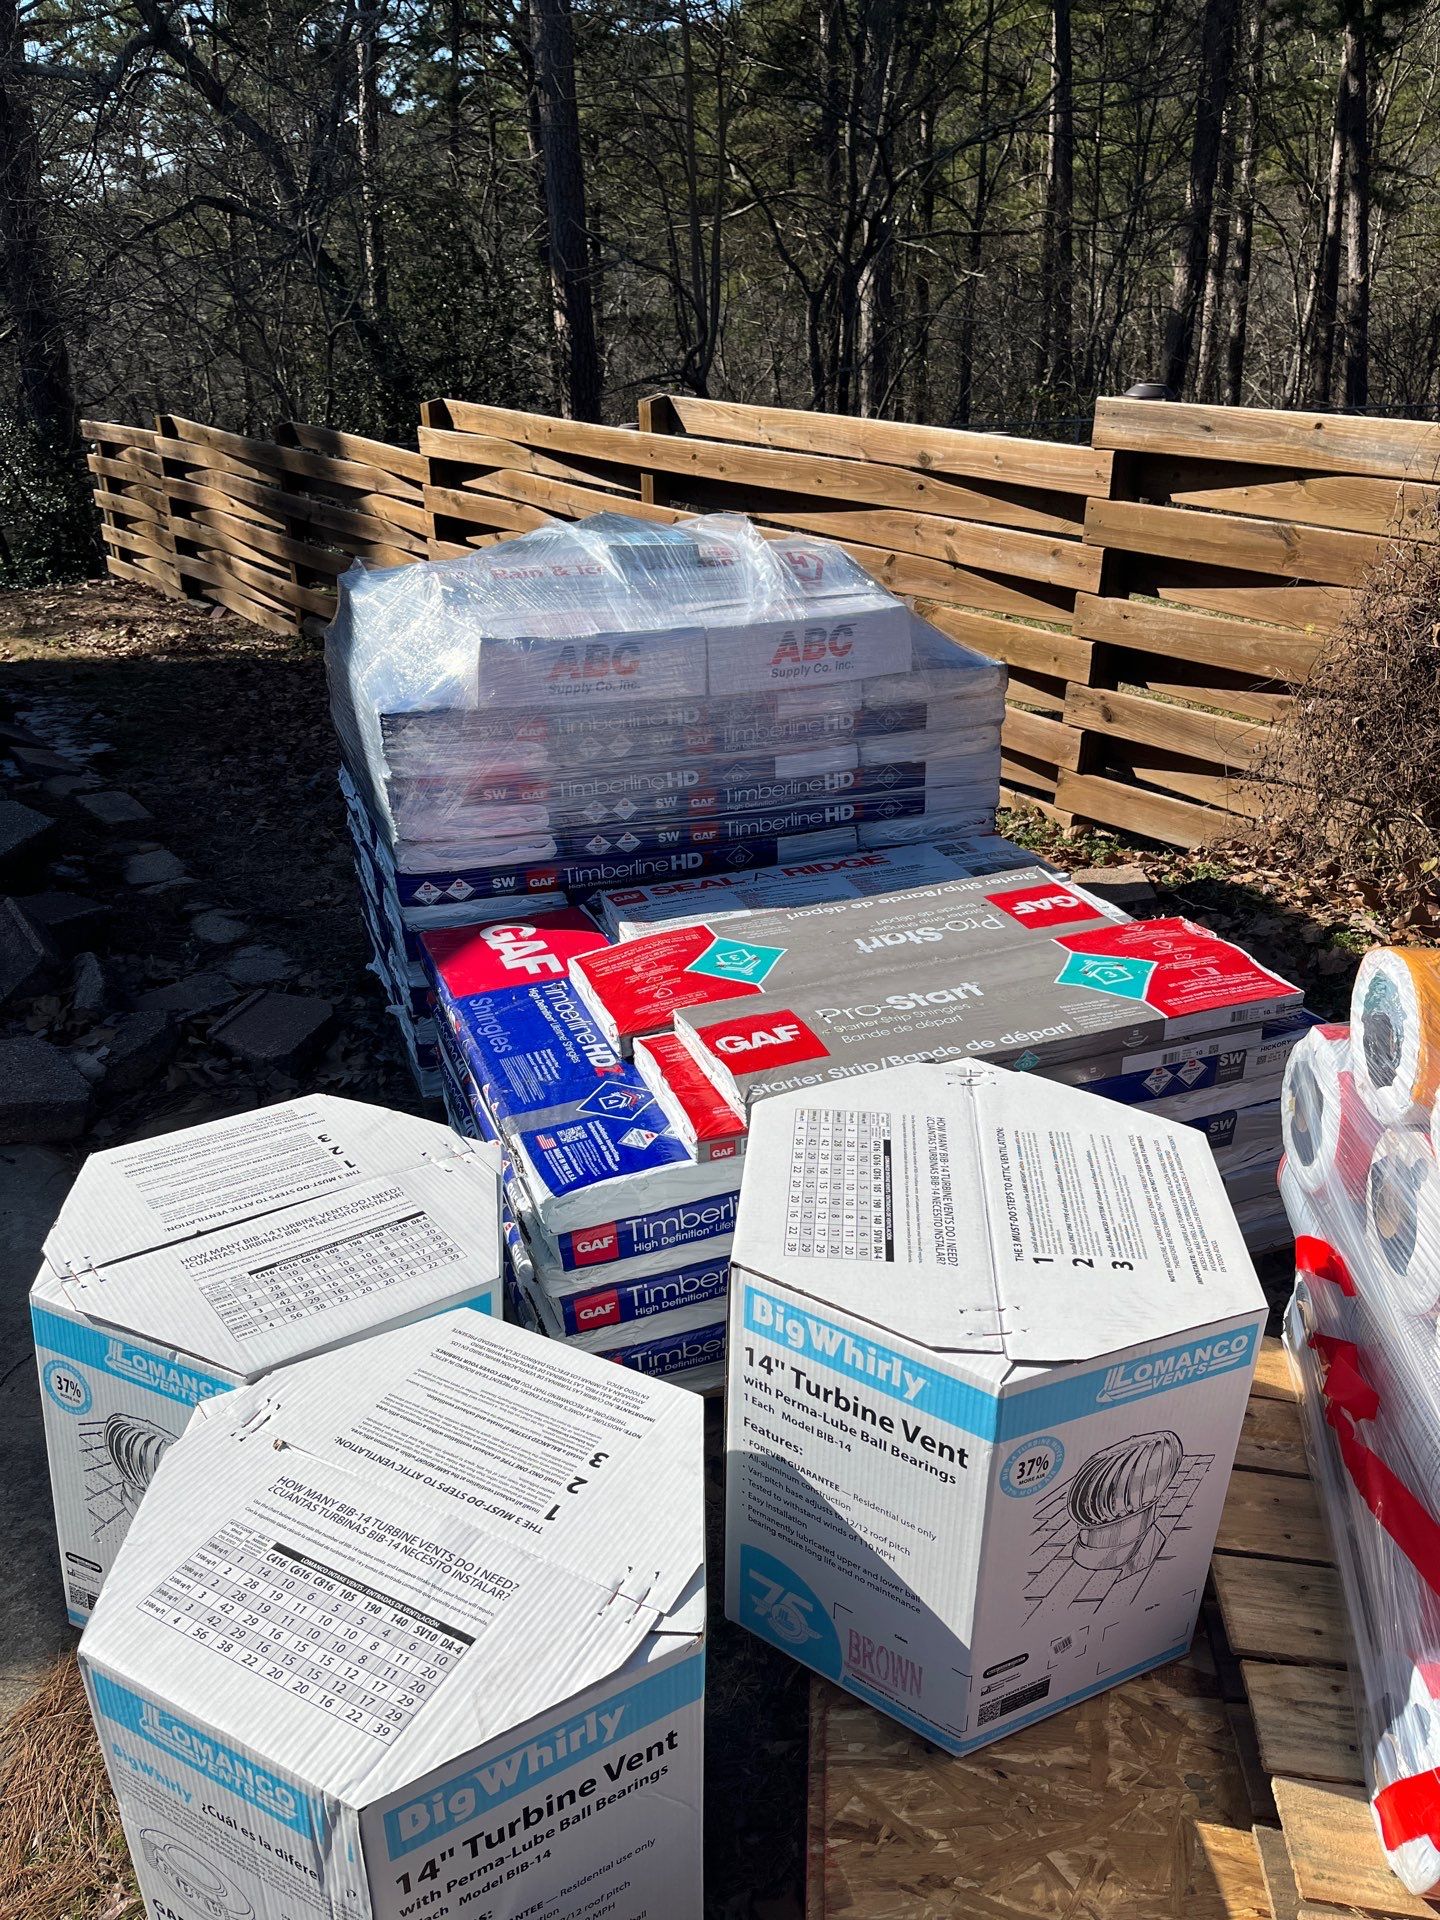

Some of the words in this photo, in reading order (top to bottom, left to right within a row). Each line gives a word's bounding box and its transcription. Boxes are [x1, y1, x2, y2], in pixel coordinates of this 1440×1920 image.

[546, 642, 642, 682] ABC
[769, 622, 857, 666] ABC
[548, 680, 591, 696] Supply
[771, 663, 811, 679] Supply
[813, 662, 832, 674] Co.
[687, 733, 713, 746] GAF
[483, 787, 509, 801] SW
[521, 789, 548, 801] GAF
[655, 795, 678, 809] SW
[690, 796, 716, 808] GAF
[657, 830, 680, 843] SW
[692, 829, 718, 842] GAF
[491, 875, 516, 889] SW
[529, 874, 556, 888] GAF
[985, 871, 1039, 888] Starter
[787, 902, 847, 921] départ
[850, 899, 874, 911] de
[1011, 895, 1080, 916] GAF
[479, 924, 565, 975] GAF
[853, 913, 1006, 955] Pro-Start
[814, 980, 986, 1025] Pro-Start
[833, 1015, 881, 1033] Starter
[880, 1010, 912, 1026] Strip
[913, 1003, 970, 1021] Shingles
[469, 996, 513, 1054] Shingles
[714, 1023, 802, 1055] GAF
[840, 1026, 890, 1045] Bande
[893, 1023, 912, 1035] de
[916, 1013, 963, 1032] départ
[1260, 1037, 1293, 1053] HICKORY
[748, 1071, 825, 1098] Starter
[965, 1038, 996, 1053] de
[999, 1021, 1073, 1046] départ
[1218, 1051, 1244, 1067] SW
[1208, 1117, 1235, 1133] SW
[712, 1147, 734, 1158] GAF
[576, 1234, 615, 1254] GAF
[633, 1239, 660, 1255] High
[579, 1301, 616, 1321] GAF
[627, 1269, 730, 1307] Timber
[634, 1302, 660, 1317] High
[752, 1293, 928, 1401] BigWhirly
[1107, 1334, 1249, 1390] LOMANCO
[56, 1375, 82, 1399] 37%
[149, 1375, 198, 1402] VENTS
[1151, 1364, 1207, 1389] VENTS
[743, 1374, 772, 1398] with
[775, 1387, 858, 1438] Perma-Lube
[859, 1426, 888, 1453] Ball
[890, 1445, 957, 1485] Bearings
[743, 1416, 804, 1456] Features:
[751, 1396, 775, 1415] Each
[780, 1410, 815, 1435] Model
[816, 1426, 852, 1453] BIB-14
[790, 1365, 896, 1435] Turbine
[900, 1417, 971, 1470] Vent
[748, 1451, 800, 1486] All-aluminum
[800, 1481, 852, 1512] construction
[1016, 1454, 1050, 1480] 37%
[1018, 1476, 1035, 1486] MORE
[747, 1491, 765, 1507] Easy
[748, 1438, 788, 1463] FOREVER
[787, 1457, 841, 1492] GUARANTEE
[853, 1493, 900, 1522] Residential
[900, 1518, 916, 1531] use
[917, 1525, 937, 1542] only
[748, 1465, 784, 1490] Vari-pitch
[785, 1484, 804, 1501] base
[804, 1494, 831, 1516] adjusts
[845, 1516, 868, 1535] 12/12
[869, 1530, 887, 1545] roof
[888, 1539, 911, 1557] pitch
[748, 1478, 773, 1498] Tested
[783, 1497, 822, 1524] withstand
[822, 1519, 848, 1536] winds
[874, 1545, 896, 1562] MPH
[268, 1484, 321, 1513] ¿CUÁNTAS
[318, 1506, 369, 1536] TURBINAS
[366, 1530, 403, 1551] BIB-14
[400, 1544, 453, 1574] NECESITO
[451, 1569, 511, 1602] INSTALAR?
[277, 1475, 308, 1495] HOW
[303, 1488, 340, 1508] MANY
[336, 1503, 373, 1525] BIB-14
[371, 1518, 420, 1546] TURBINE
[419, 1538, 456, 1563] VENTS
[453, 1557, 475, 1573] DO
[480, 1569, 520, 1592] NEED?
[747, 1504, 795, 1536] Permanently
[796, 1530, 836, 1557] lubricated
[836, 1552, 862, 1571] upper
[862, 1566, 879, 1580] and
[879, 1572, 904, 1592] lower
[904, 1588, 921, 1604] ball
[747, 1514, 777, 1537] bearing
[777, 1531, 804, 1551] ensure
[804, 1545, 822, 1562] long
[822, 1554, 837, 1567] life
[837, 1564, 853, 1578] and
[854, 1573, 866, 1585] no
[866, 1579, 922, 1614] maintenance
[847, 1628, 924, 1699] BROWN
[142, 1700, 297, 1816] LOMANCO
[197, 1752, 256, 1799] VENTS
[399, 1702, 630, 1844] BigWhirly
[462, 1777, 598, 1860] Turbine
[602, 1729, 680, 1784] Vent
[200, 1801, 239, 1831] ¿Cuál
[240, 1826, 257, 1842] es
[258, 1833, 272, 1852] la
[398, 1887, 443, 1919] with
[446, 1826, 556, 1894] Perma-Lube
[559, 1801, 593, 1833] Ball
[595, 1763, 670, 1813] Bearings
[457, 1875, 505, 1907] Model
[506, 1848, 553, 1881] BIB-14
